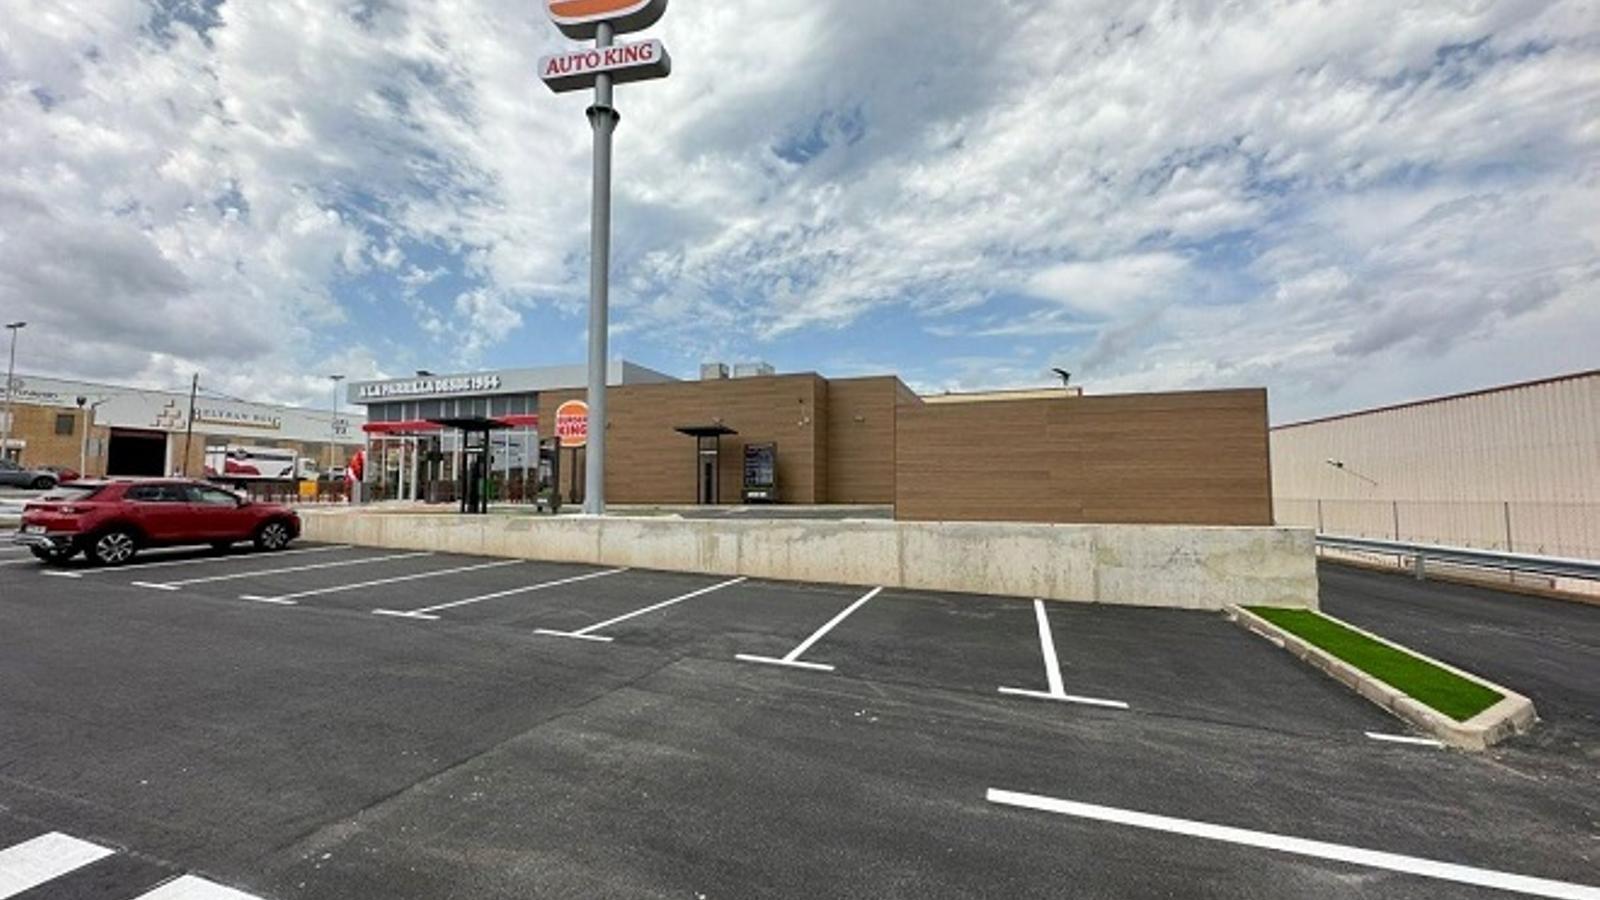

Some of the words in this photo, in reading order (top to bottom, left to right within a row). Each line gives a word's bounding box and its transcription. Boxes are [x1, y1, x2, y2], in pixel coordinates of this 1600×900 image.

[546, 50, 600, 75] AUTO
[604, 43, 653, 66] KING
[559, 424, 587, 435] KING
